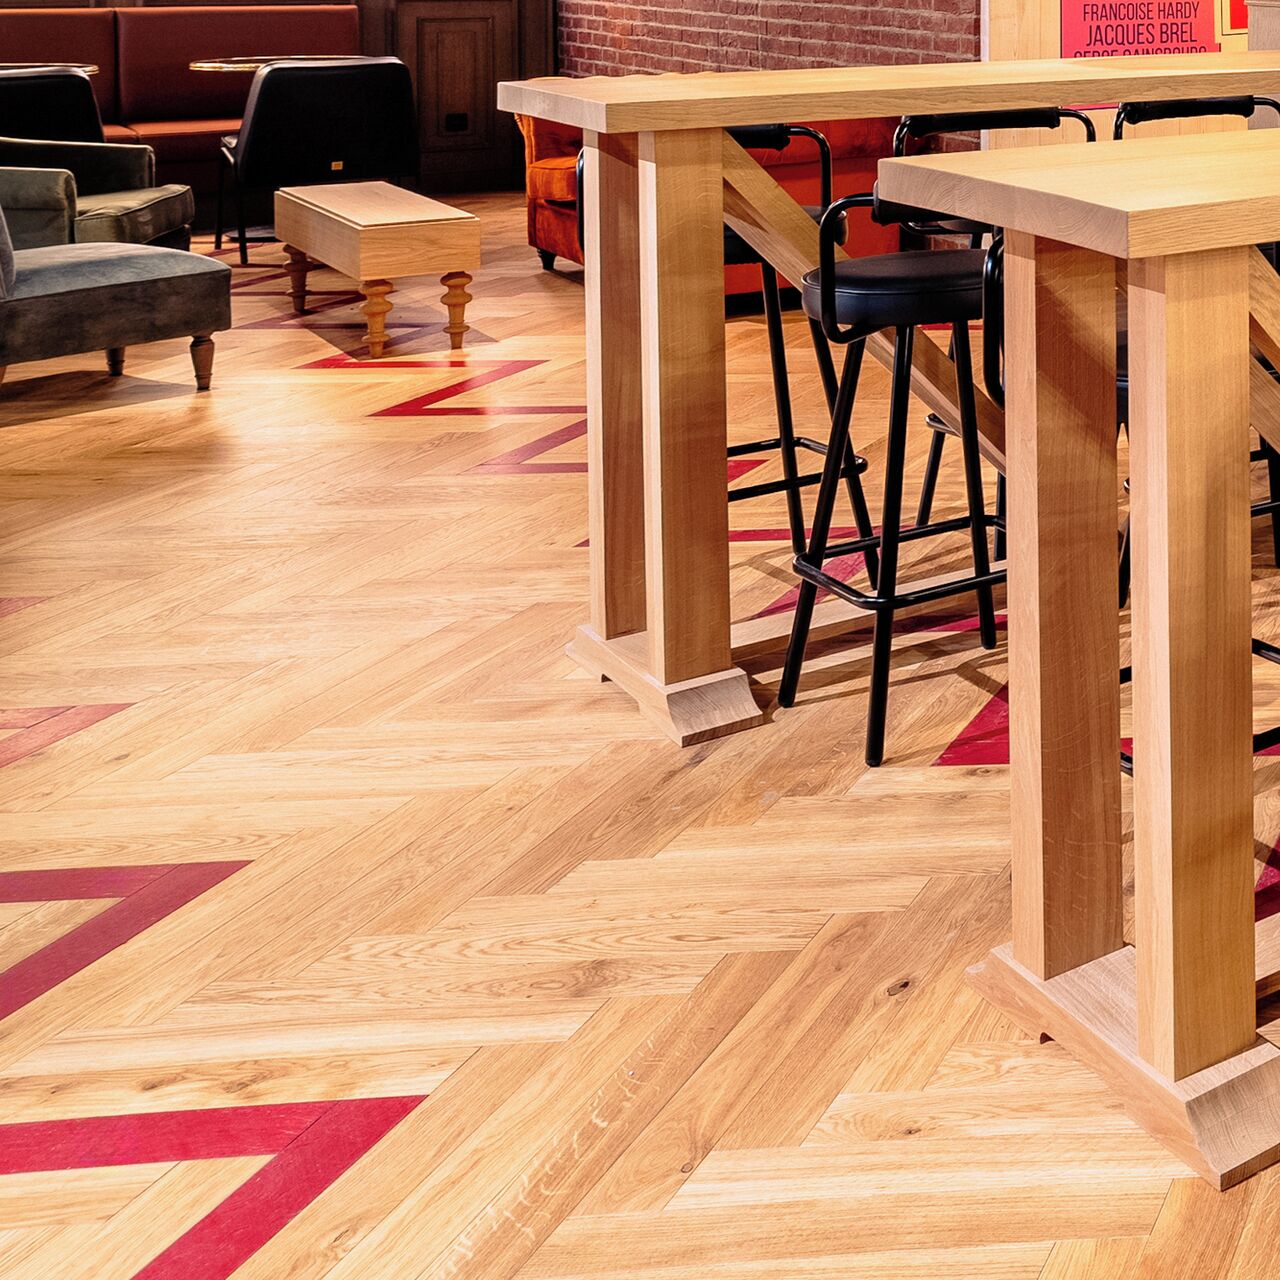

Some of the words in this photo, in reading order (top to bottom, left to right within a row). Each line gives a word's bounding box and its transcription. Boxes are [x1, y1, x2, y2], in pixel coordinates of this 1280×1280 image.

[1083, 2, 1154, 22] FRANCOISE
[1158, 1, 1200, 20] HARDY
[1086, 23, 1155, 47] JACQUES
[1160, 22, 1198, 44] BREL
